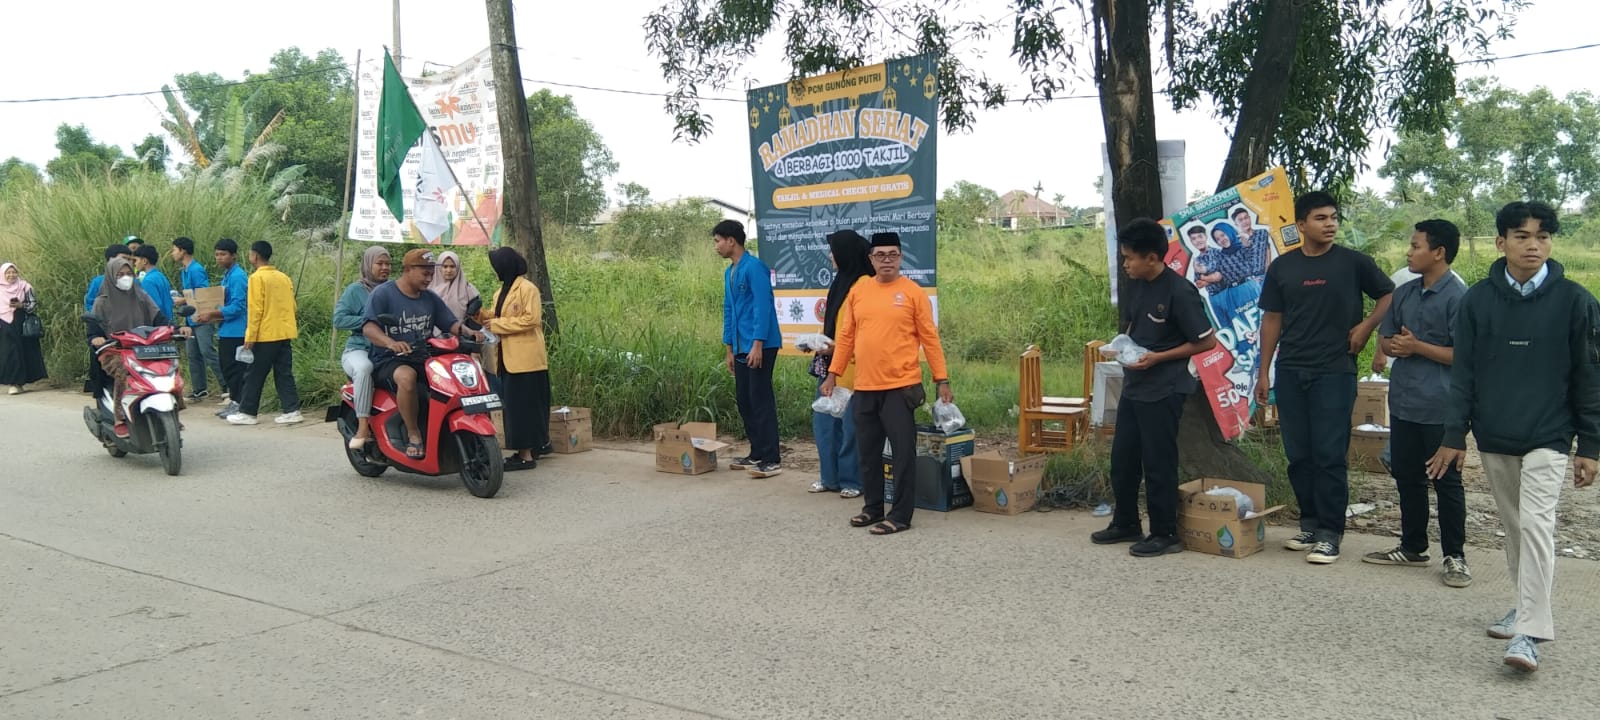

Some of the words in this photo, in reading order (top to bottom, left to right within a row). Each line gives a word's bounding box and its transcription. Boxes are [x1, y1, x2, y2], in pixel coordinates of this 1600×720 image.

[807, 84, 824, 95] PCM
[858, 72, 881, 86] PUTRI
[759, 109, 856, 172] RAMADHAN
[859, 107, 929, 151] SEHAT
[775, 164, 783, 177] &
[787, 158, 831, 174] BERBAGI
[835, 152, 861, 170] 1000
[863, 147, 908, 167] TAKJIL
[841, 186, 867, 196] CHECK
[869, 184, 879, 193] UP
[880, 181, 910, 192] GRATIS
[1179, 206, 1195, 219] SMA
[901, 225, 930, 235] berpuasa
[1216, 388, 1240, 408] 50
